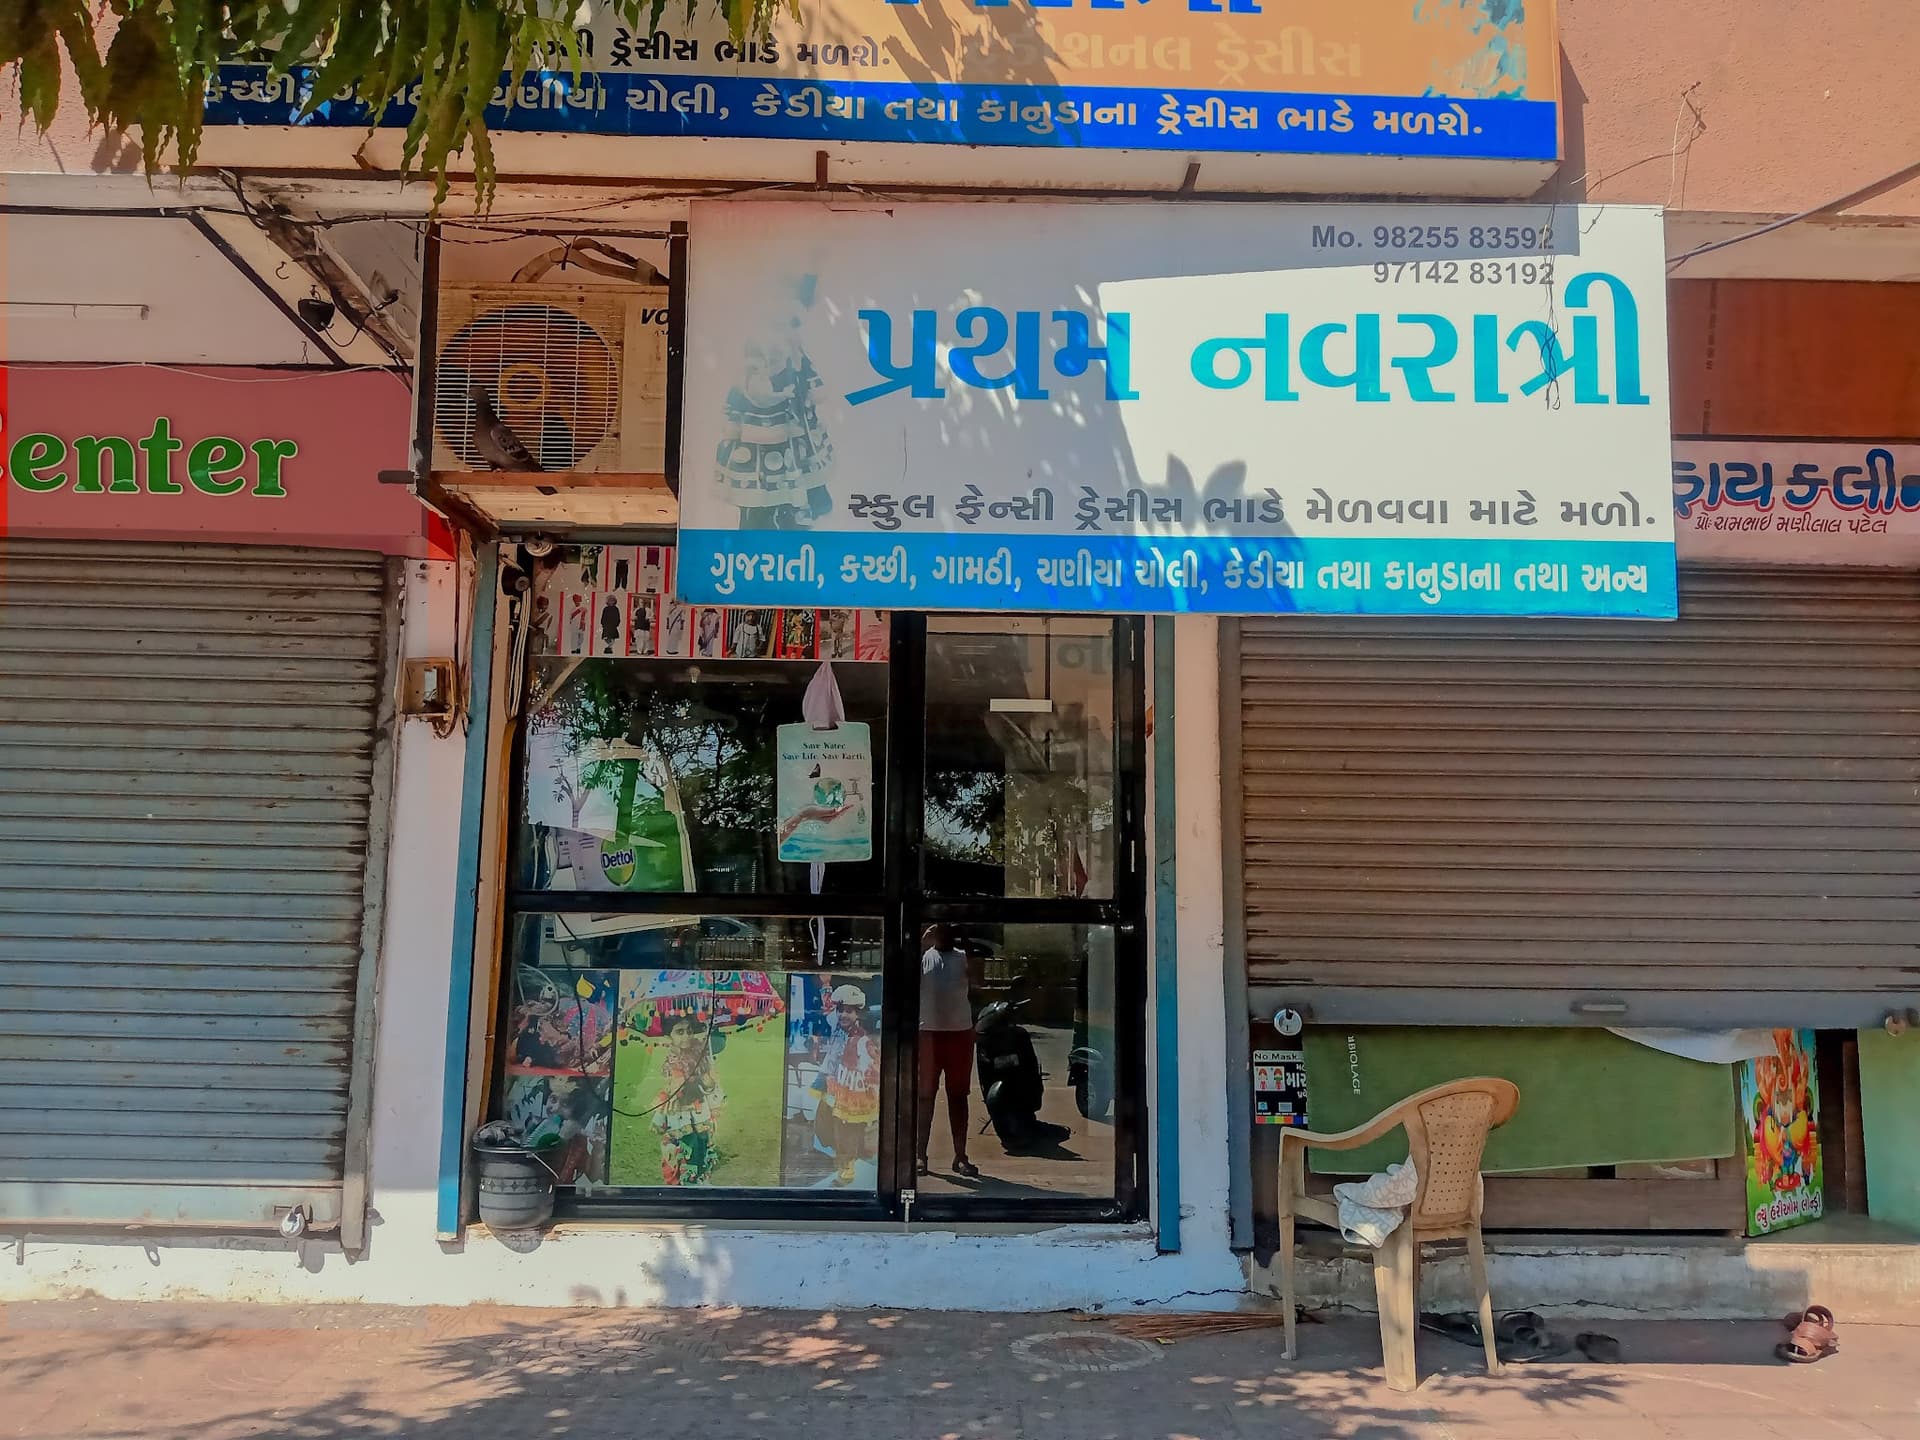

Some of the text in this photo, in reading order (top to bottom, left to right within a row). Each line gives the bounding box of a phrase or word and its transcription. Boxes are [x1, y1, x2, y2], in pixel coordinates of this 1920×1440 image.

[610, 28, 698, 67] ડ્રેસીસ
[796, 36, 891, 67] મળશે.
[625, 80, 730, 121] ચોલી,
[751, 83, 865, 119] કેડીયા
[883, 97, 959, 122] તથા
[976, 98, 1137, 134] કાનુડાના
[1156, 94, 1259, 135] ડ્રેસીસ
[1276, 99, 1355, 133] ભાડે
[1372, 103, 1483, 136] મળશે.
[1311, 225, 1555, 250] Mo. 98255 83592
[1373, 261, 1555, 285] 97142 83192
[844, 271, 1651, 408] પ્રથમ નવરાત્રી
[0, 413, 299, 498] enter
[847, 483, 1657, 531] સ્કુલ ફેન્સી ડ્રેસીસ ભાડે મેળવવા માટે મળો.
[1849, 512, 1888, 535] પટેલ
[710, 543, 1648, 606] ગુજરાતી, કચ્છી, ગામઠી, ચણીયા ચોલી, કેડીયા તથા કાનુડાના તથા અન્ય
[782, 751, 800, 761] Save
[803, 741, 821, 750] Save
[602, 848, 634, 869] Dettol
[1254, 1052, 1269, 1061] No
